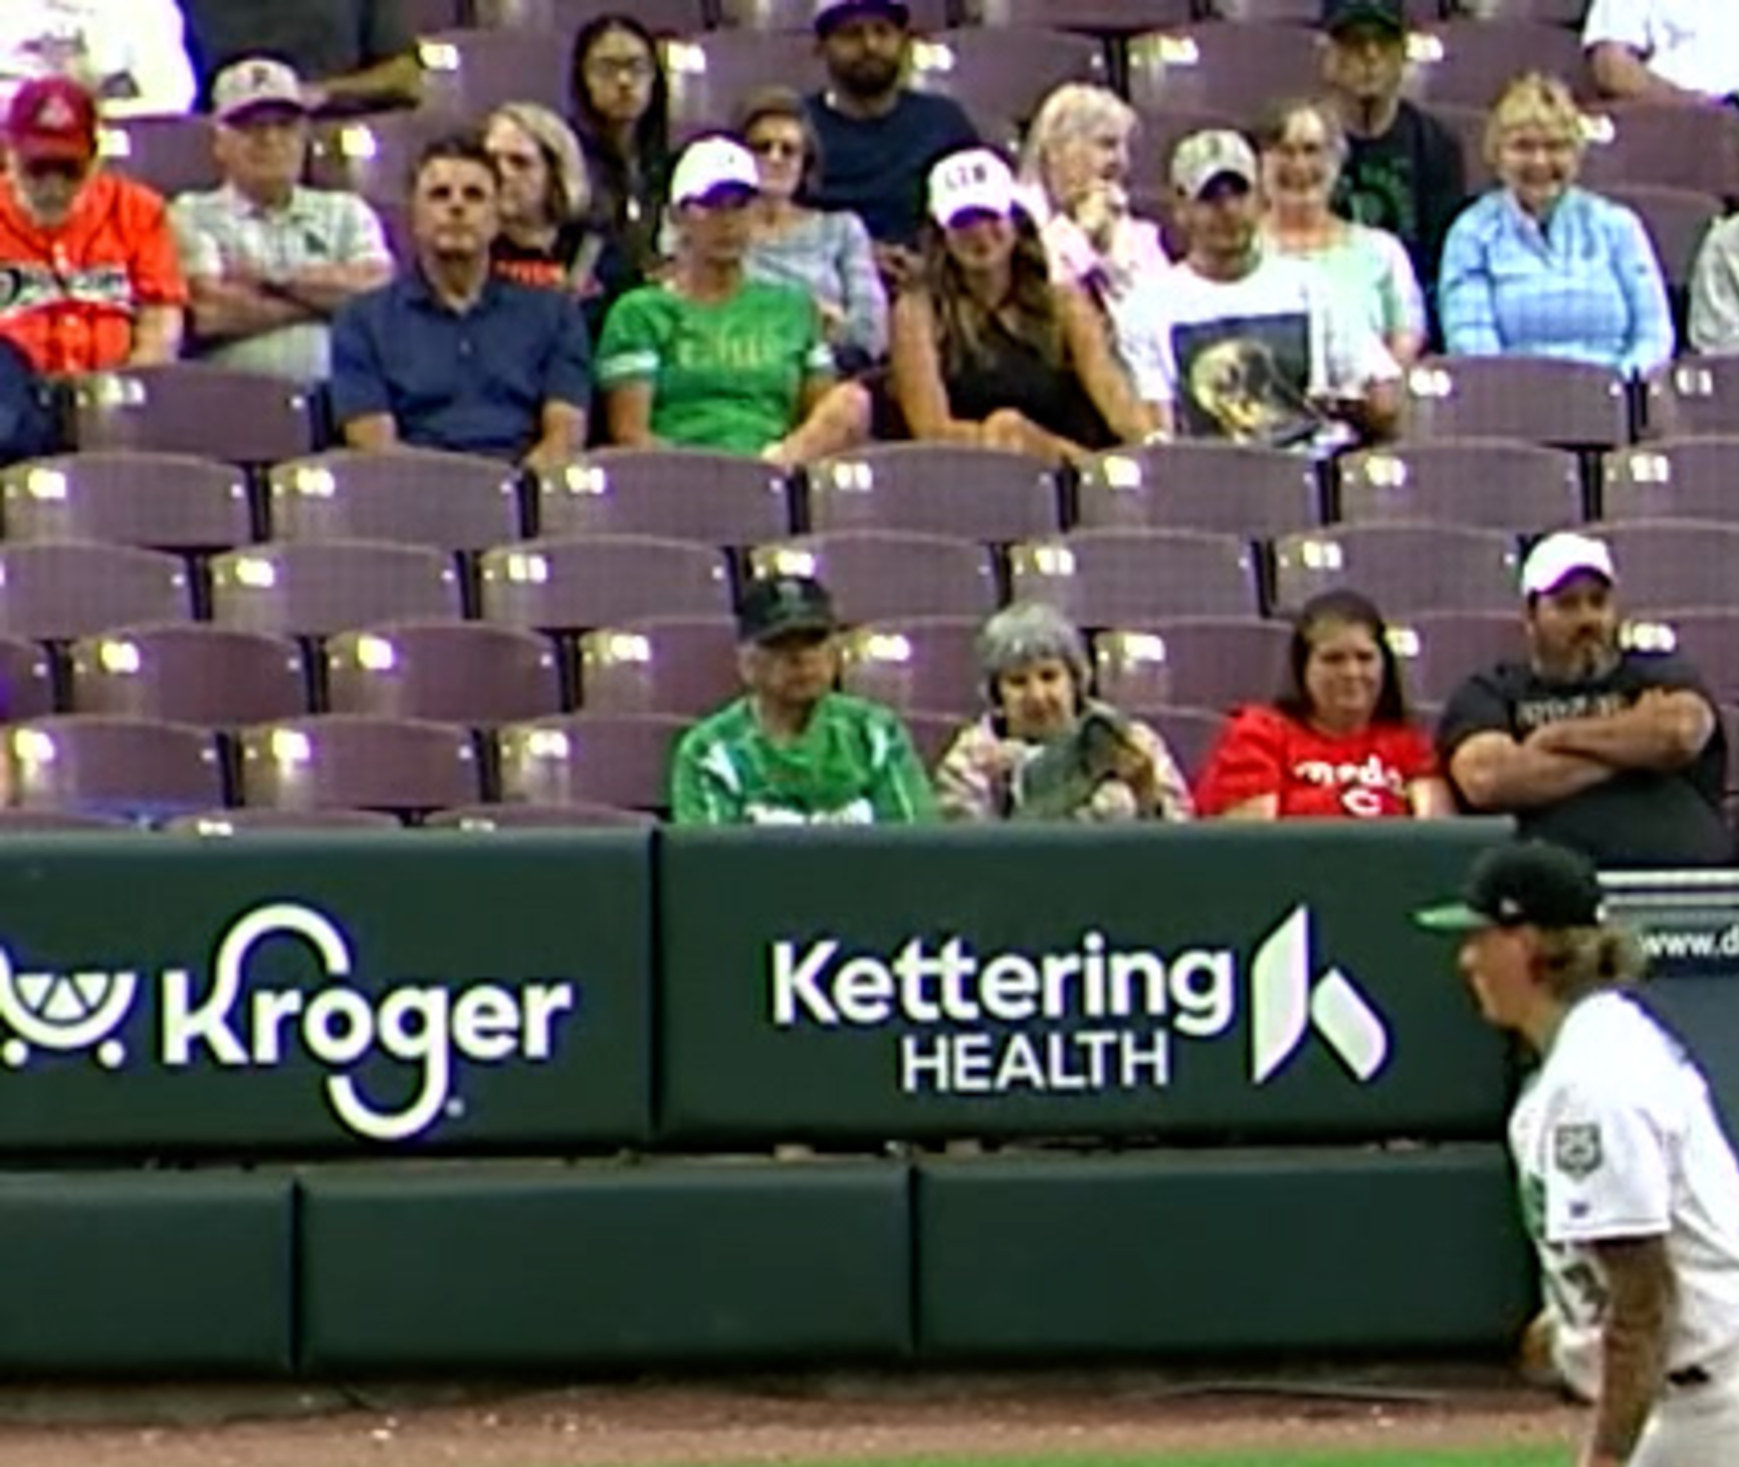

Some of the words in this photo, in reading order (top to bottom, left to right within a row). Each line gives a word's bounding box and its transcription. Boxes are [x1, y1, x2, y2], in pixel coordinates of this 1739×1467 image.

[163, 904, 572, 1138] Kroger
[774, 932, 1233, 1041] Kettering
[903, 1030, 1168, 1090] HEALTH
